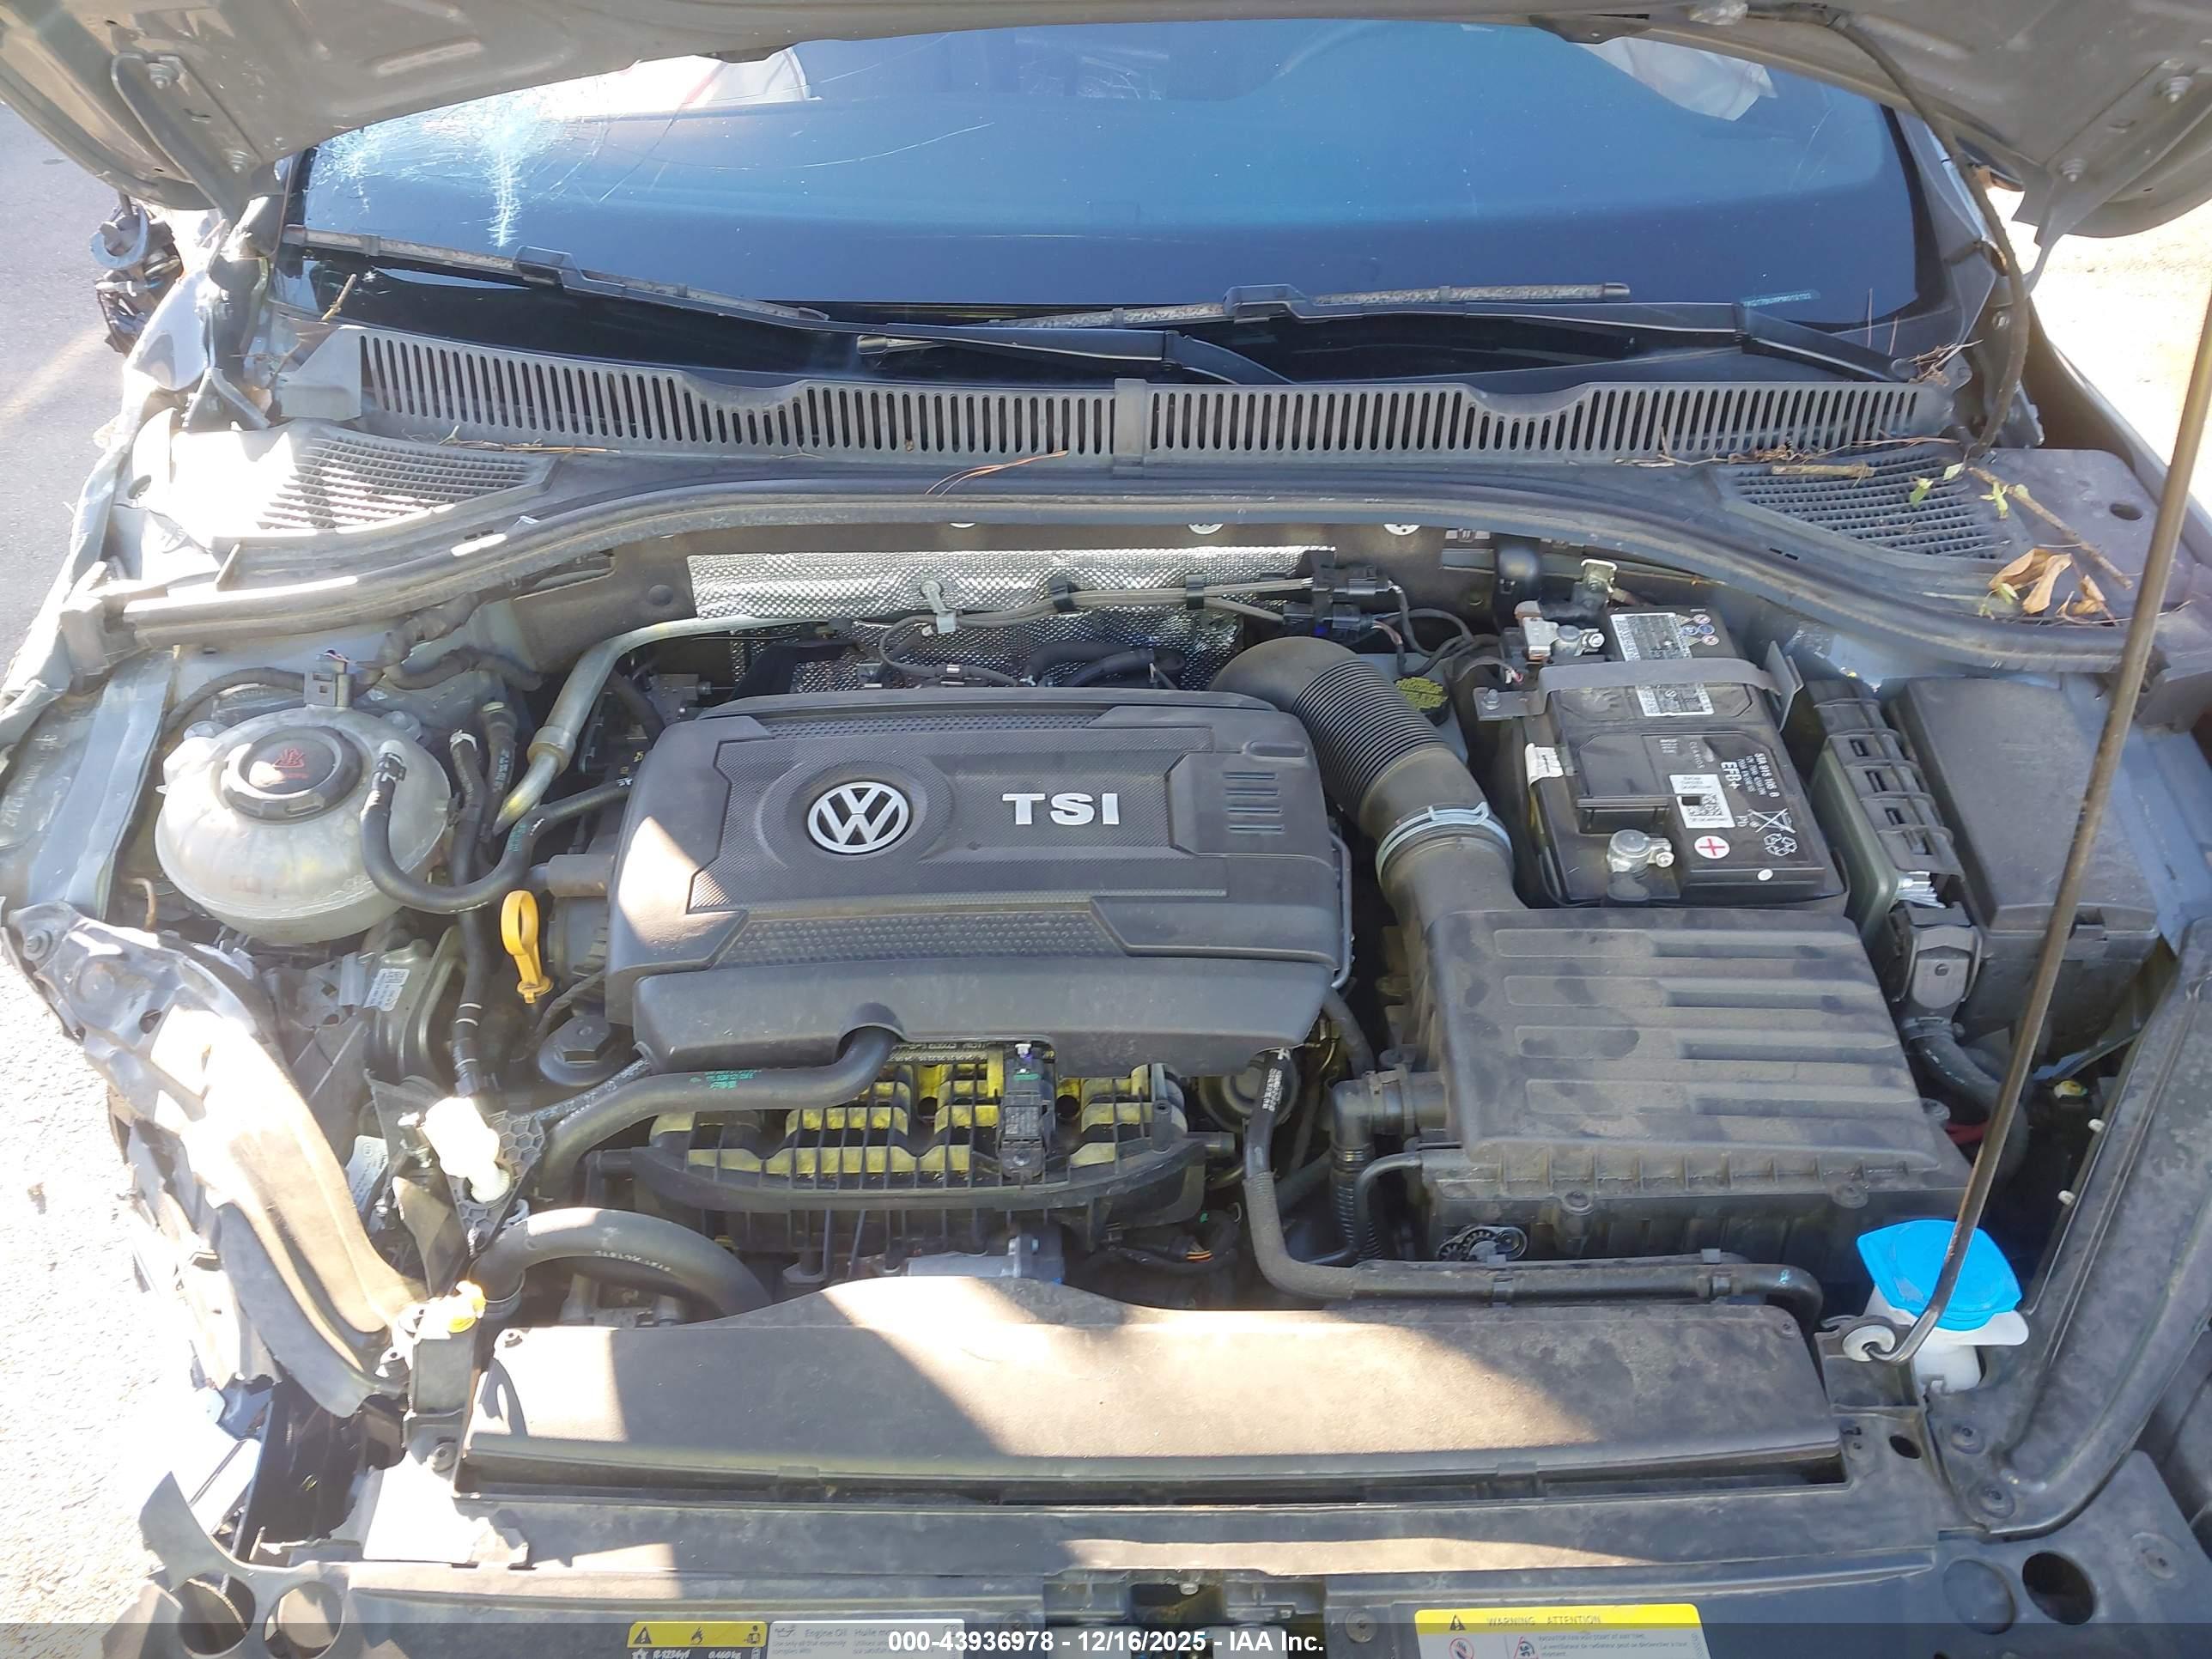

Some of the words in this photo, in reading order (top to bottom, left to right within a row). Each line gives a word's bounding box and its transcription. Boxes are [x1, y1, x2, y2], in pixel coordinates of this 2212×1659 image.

[1721, 762, 1742, 789] EFB+
[1002, 793, 1120, 825] TSI
[1487, 1617, 1535, 1626] WARNING
[1547, 1614, 1601, 1625] ATTENTION
[805, 1629, 833, 1639] Engine
